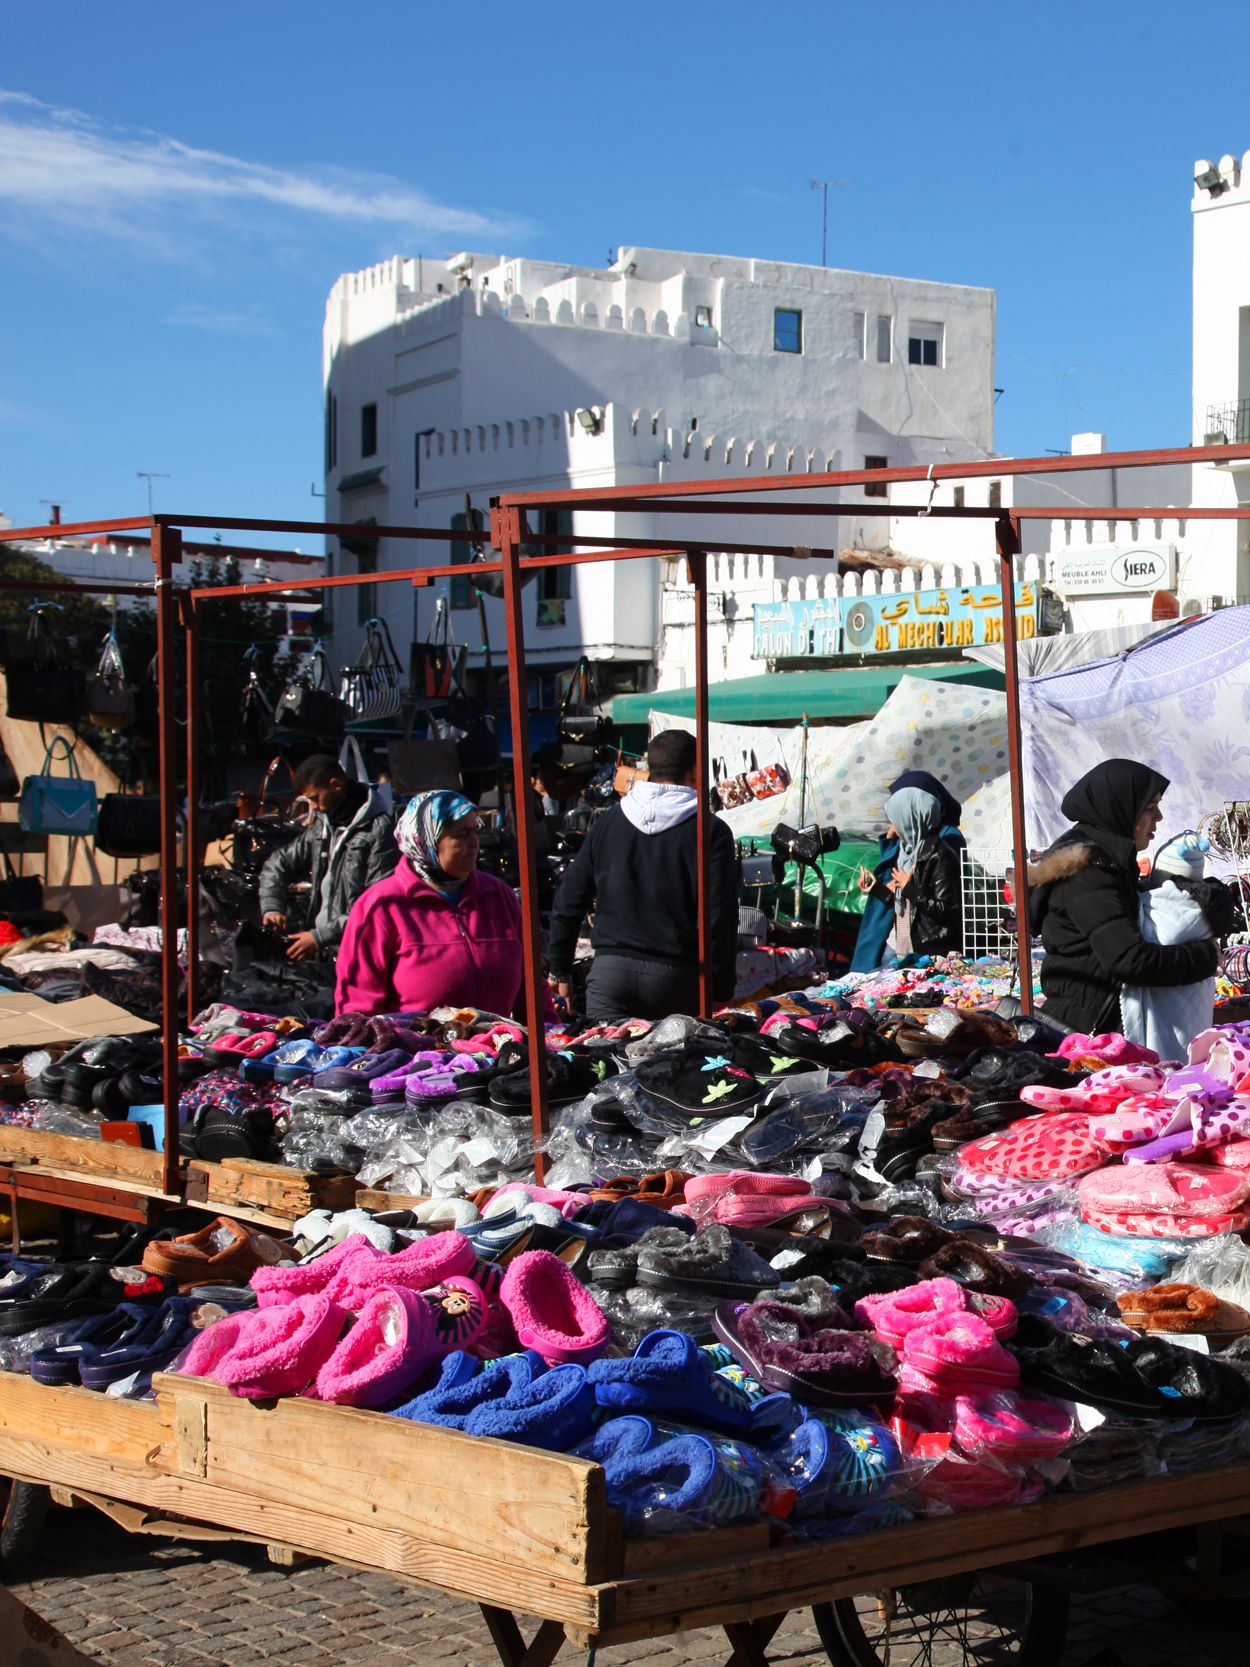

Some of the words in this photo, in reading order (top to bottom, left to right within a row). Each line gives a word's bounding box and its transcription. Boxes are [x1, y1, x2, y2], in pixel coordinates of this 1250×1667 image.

[1062, 570, 1089, 578] MEUBLE
[1091, 569, 1107, 577] AHLI
[1123, 557, 1156, 582] SIERA
[880, 588, 950, 626] شاي
[755, 630, 794, 656] SALON
[875, 624, 891, 651] AL
[897, 618, 974, 649] MECHOUAR
[984, 614, 1035, 643] ASID
